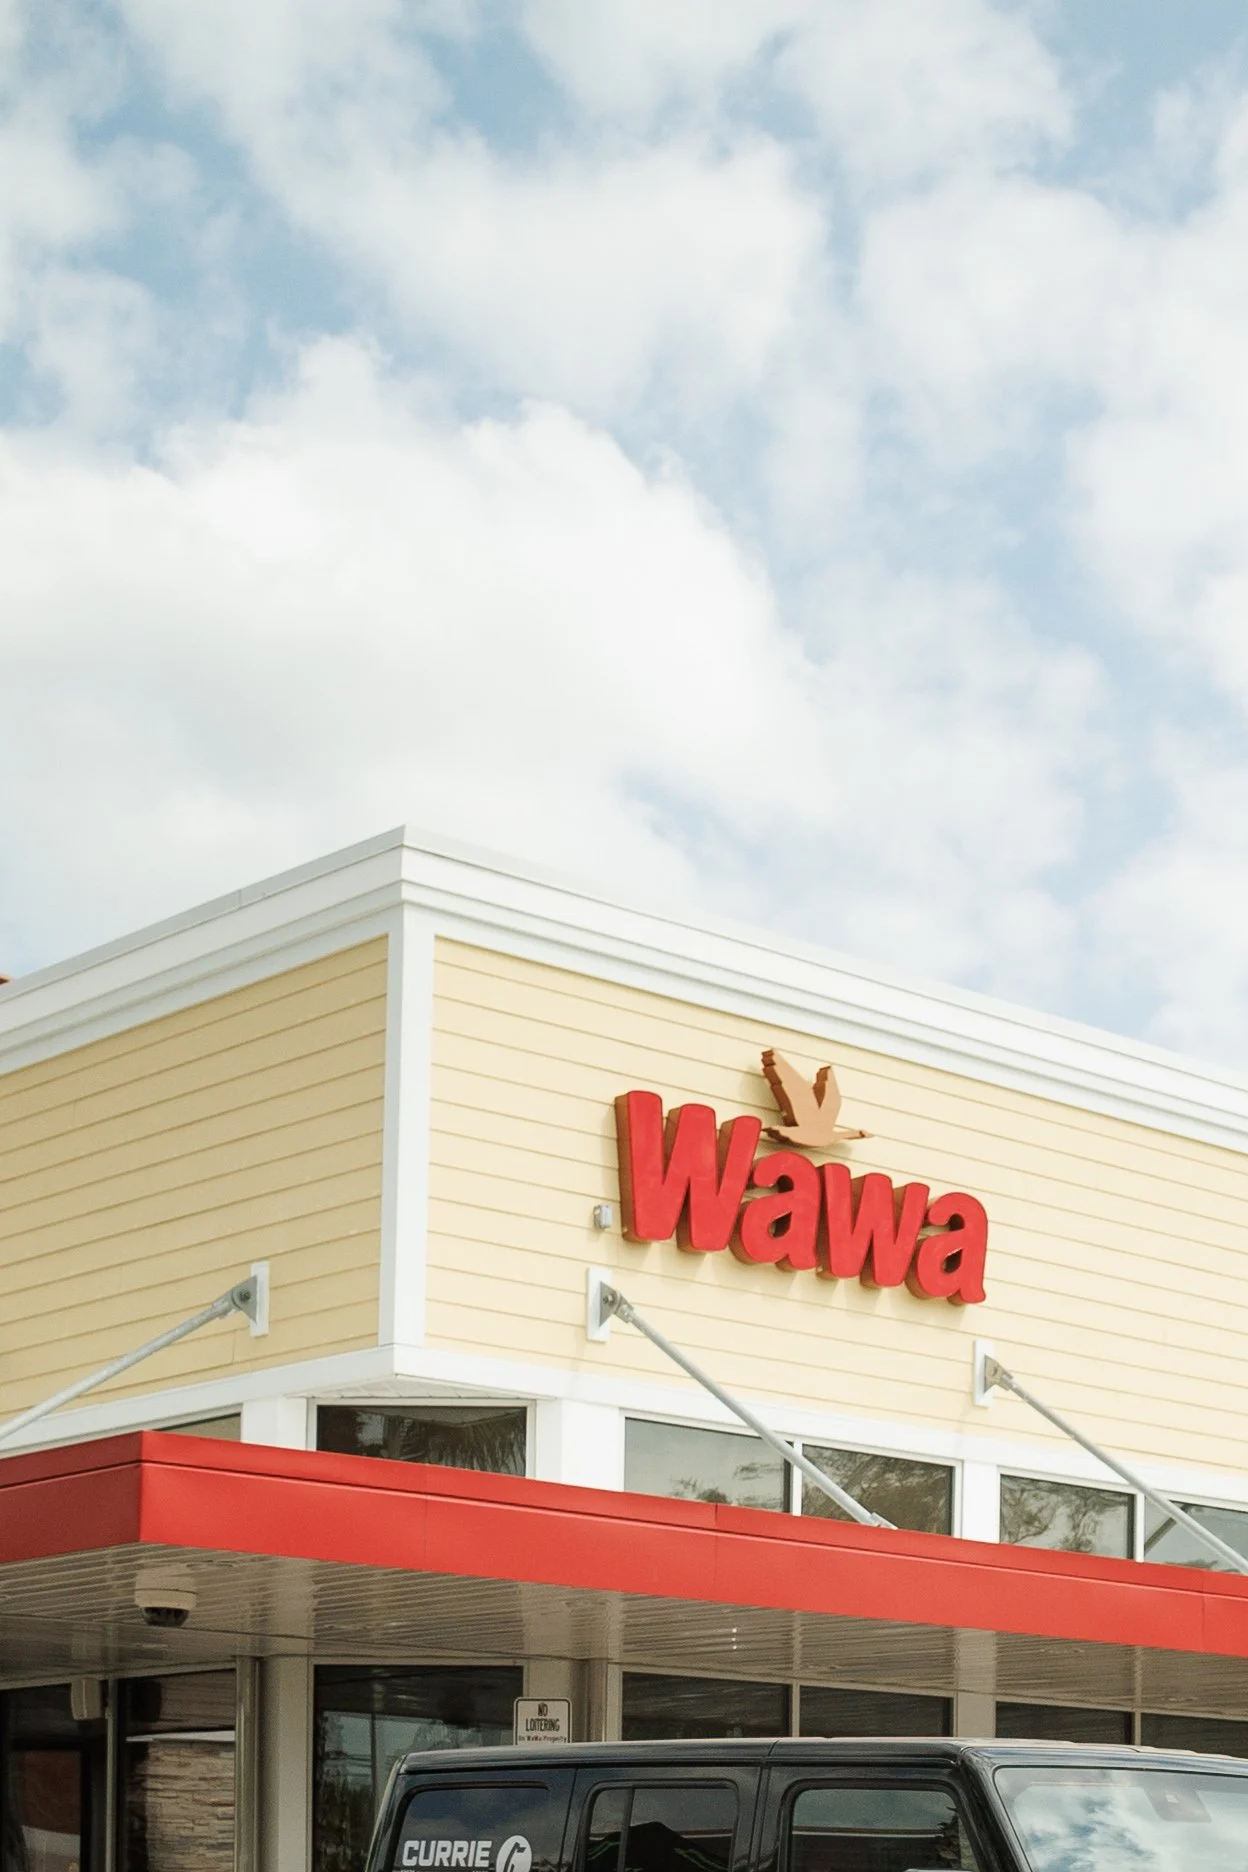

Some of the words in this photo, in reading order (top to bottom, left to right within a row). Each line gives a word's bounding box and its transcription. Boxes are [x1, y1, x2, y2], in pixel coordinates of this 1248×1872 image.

[614, 1090, 988, 1304] Wawa
[537, 1703, 549, 1717] NO
[525, 1718, 560, 1732] LOITERING
[402, 1840, 492, 1868] CURRIE
